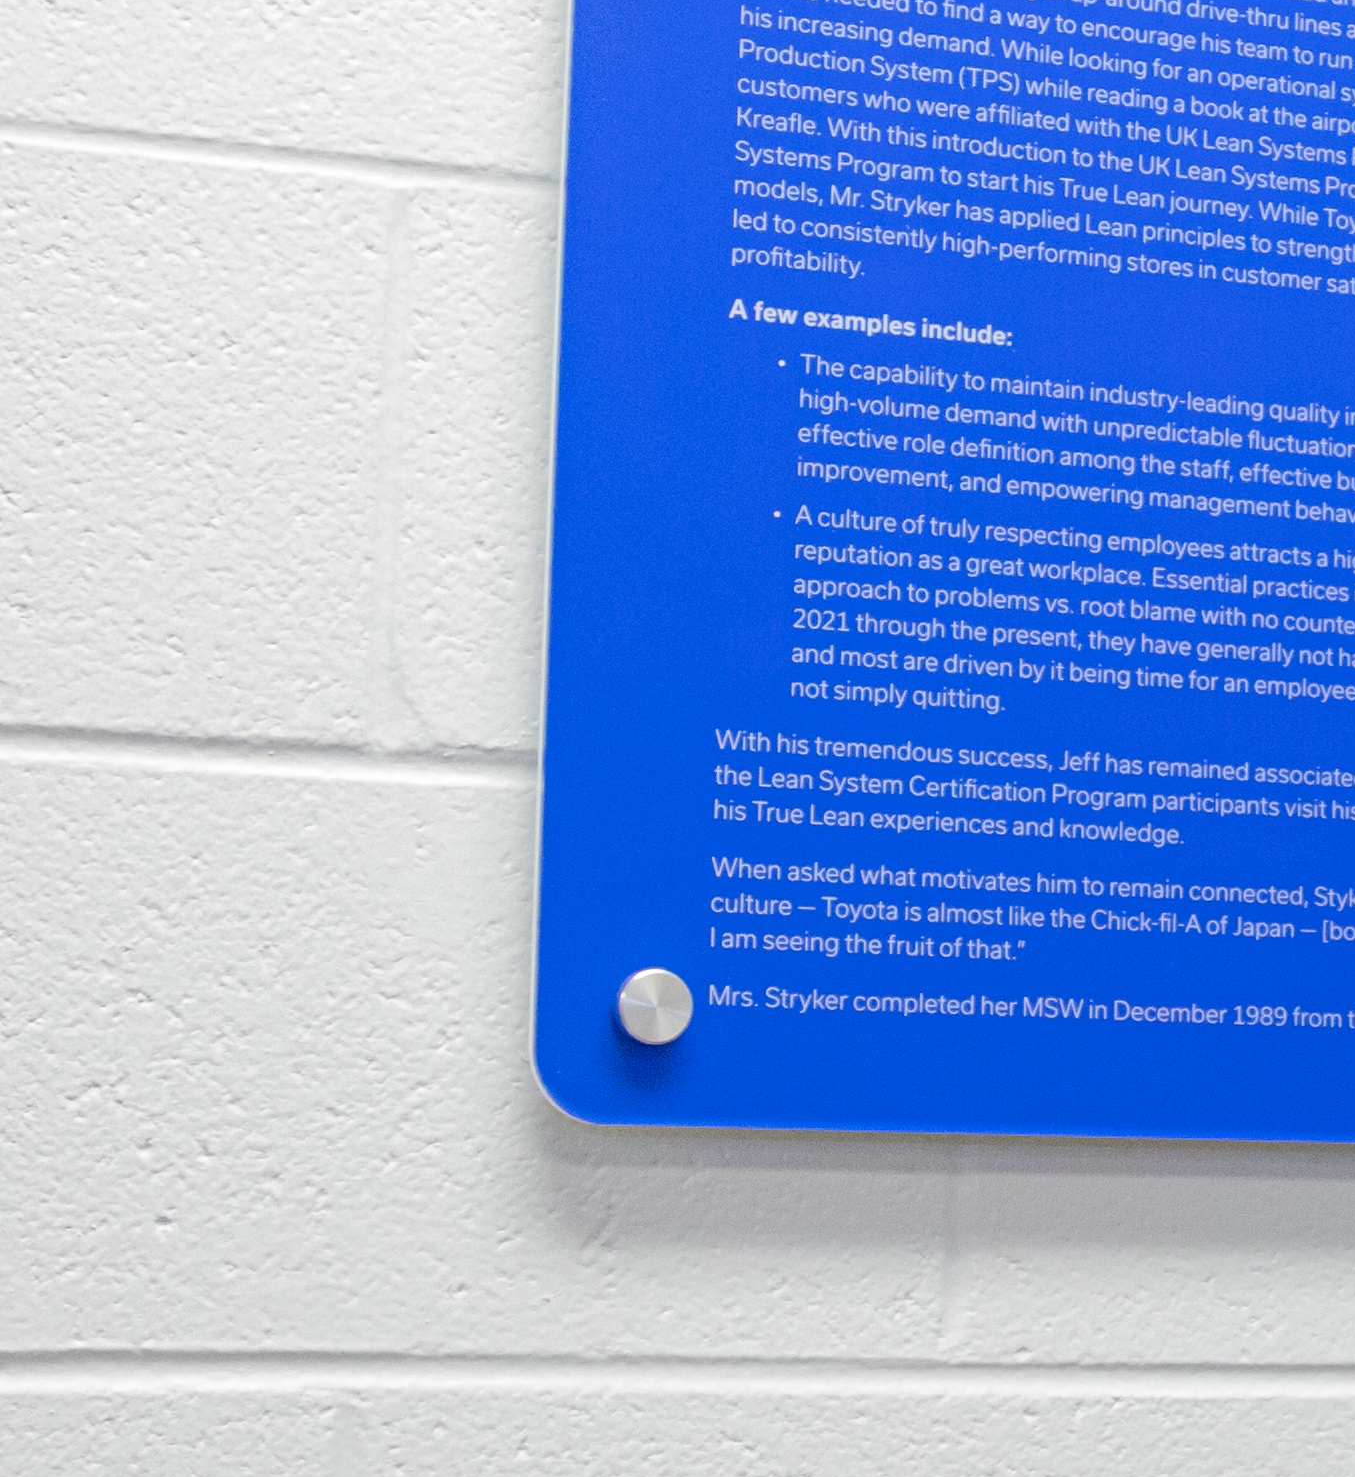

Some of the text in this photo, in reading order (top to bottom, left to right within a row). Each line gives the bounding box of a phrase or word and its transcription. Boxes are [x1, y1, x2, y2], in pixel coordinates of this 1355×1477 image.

[1293, 11, 1343, 38] lines
[736, 76, 859, 108] customers
[862, 89, 912, 114] who
[915, 99, 971, 121] were
[974, 102, 1071, 133] affiliated
[1074, 115, 1122, 138] with
[1125, 120, 1162, 144] the
[1165, 123, 1199, 148] UK
[1202, 128, 1254, 155] Lean
[1257, 135, 1348, 166] Systems
[734, 139, 833, 172] Systems
[836, 151, 935, 183] Program
[938, 165, 964, 187] to
[966, 169, 1020, 193] start
[1023, 172, 1056, 197] his
[1058, 176, 1109, 204] True
[1112, 183, 1166, 209] Lean
[1168, 189, 1254, 223] journey.
[1257, 200, 1320, 227] While
[730, 245, 866, 280] profitability.
[727, 297, 1014, 348] A few examples include:
[798, 386, 941, 422] high-volume
[944, 401, 1038, 430] demand
[1040, 411, 1089, 435] with
[1092, 420, 1244, 450] unpredictable
[799, 352, 846, 379] The
[849, 362, 960, 394] capability
[961, 370, 988, 392] to
[989, 374, 1085, 401] maintain
[1088, 381, 1266, 423] industry-leading
[1268, 401, 1342, 429] quality
[796, 455, 955, 493] improvement,
[958, 472, 1003, 495] and
[1005, 478, 1146, 511] empowering
[1148, 491, 1292, 520] management
[794, 542, 914, 568] reputation
[917, 553, 944, 572] as
[947, 554, 962, 573] a
[964, 556, 1025, 579] great
[1027, 560, 1147, 587] workplace.
[1151, 566, 1248, 595] Essential
[1252, 578, 1351, 603] practices
[789, 679, 1006, 716] not simply quitting.
[713, 763, 754, 788] the
[757, 765, 815, 791] Lean
[817, 768, 905, 797] System
[908, 773, 1047, 804] Certification
[1050, 782, 1148, 812] Program
[1151, 791, 1282, 818] participants
[1283, 797, 1328, 820] visit
[712, 797, 1185, 849] his True Lean experiences and knowledge.
[707, 983, 760, 1009] Mrs.
[764, 985, 850, 1014] Stryker
[852, 992, 977, 1018] completed
[979, 994, 1019, 1018] her
[1021, 995, 1086, 1020] MSW
[1088, 998, 1109, 1020] in
[1112, 998, 1229, 1025] December
[1233, 1004, 1289, 1027] 1989
[1291, 1005, 1343, 1029] from
